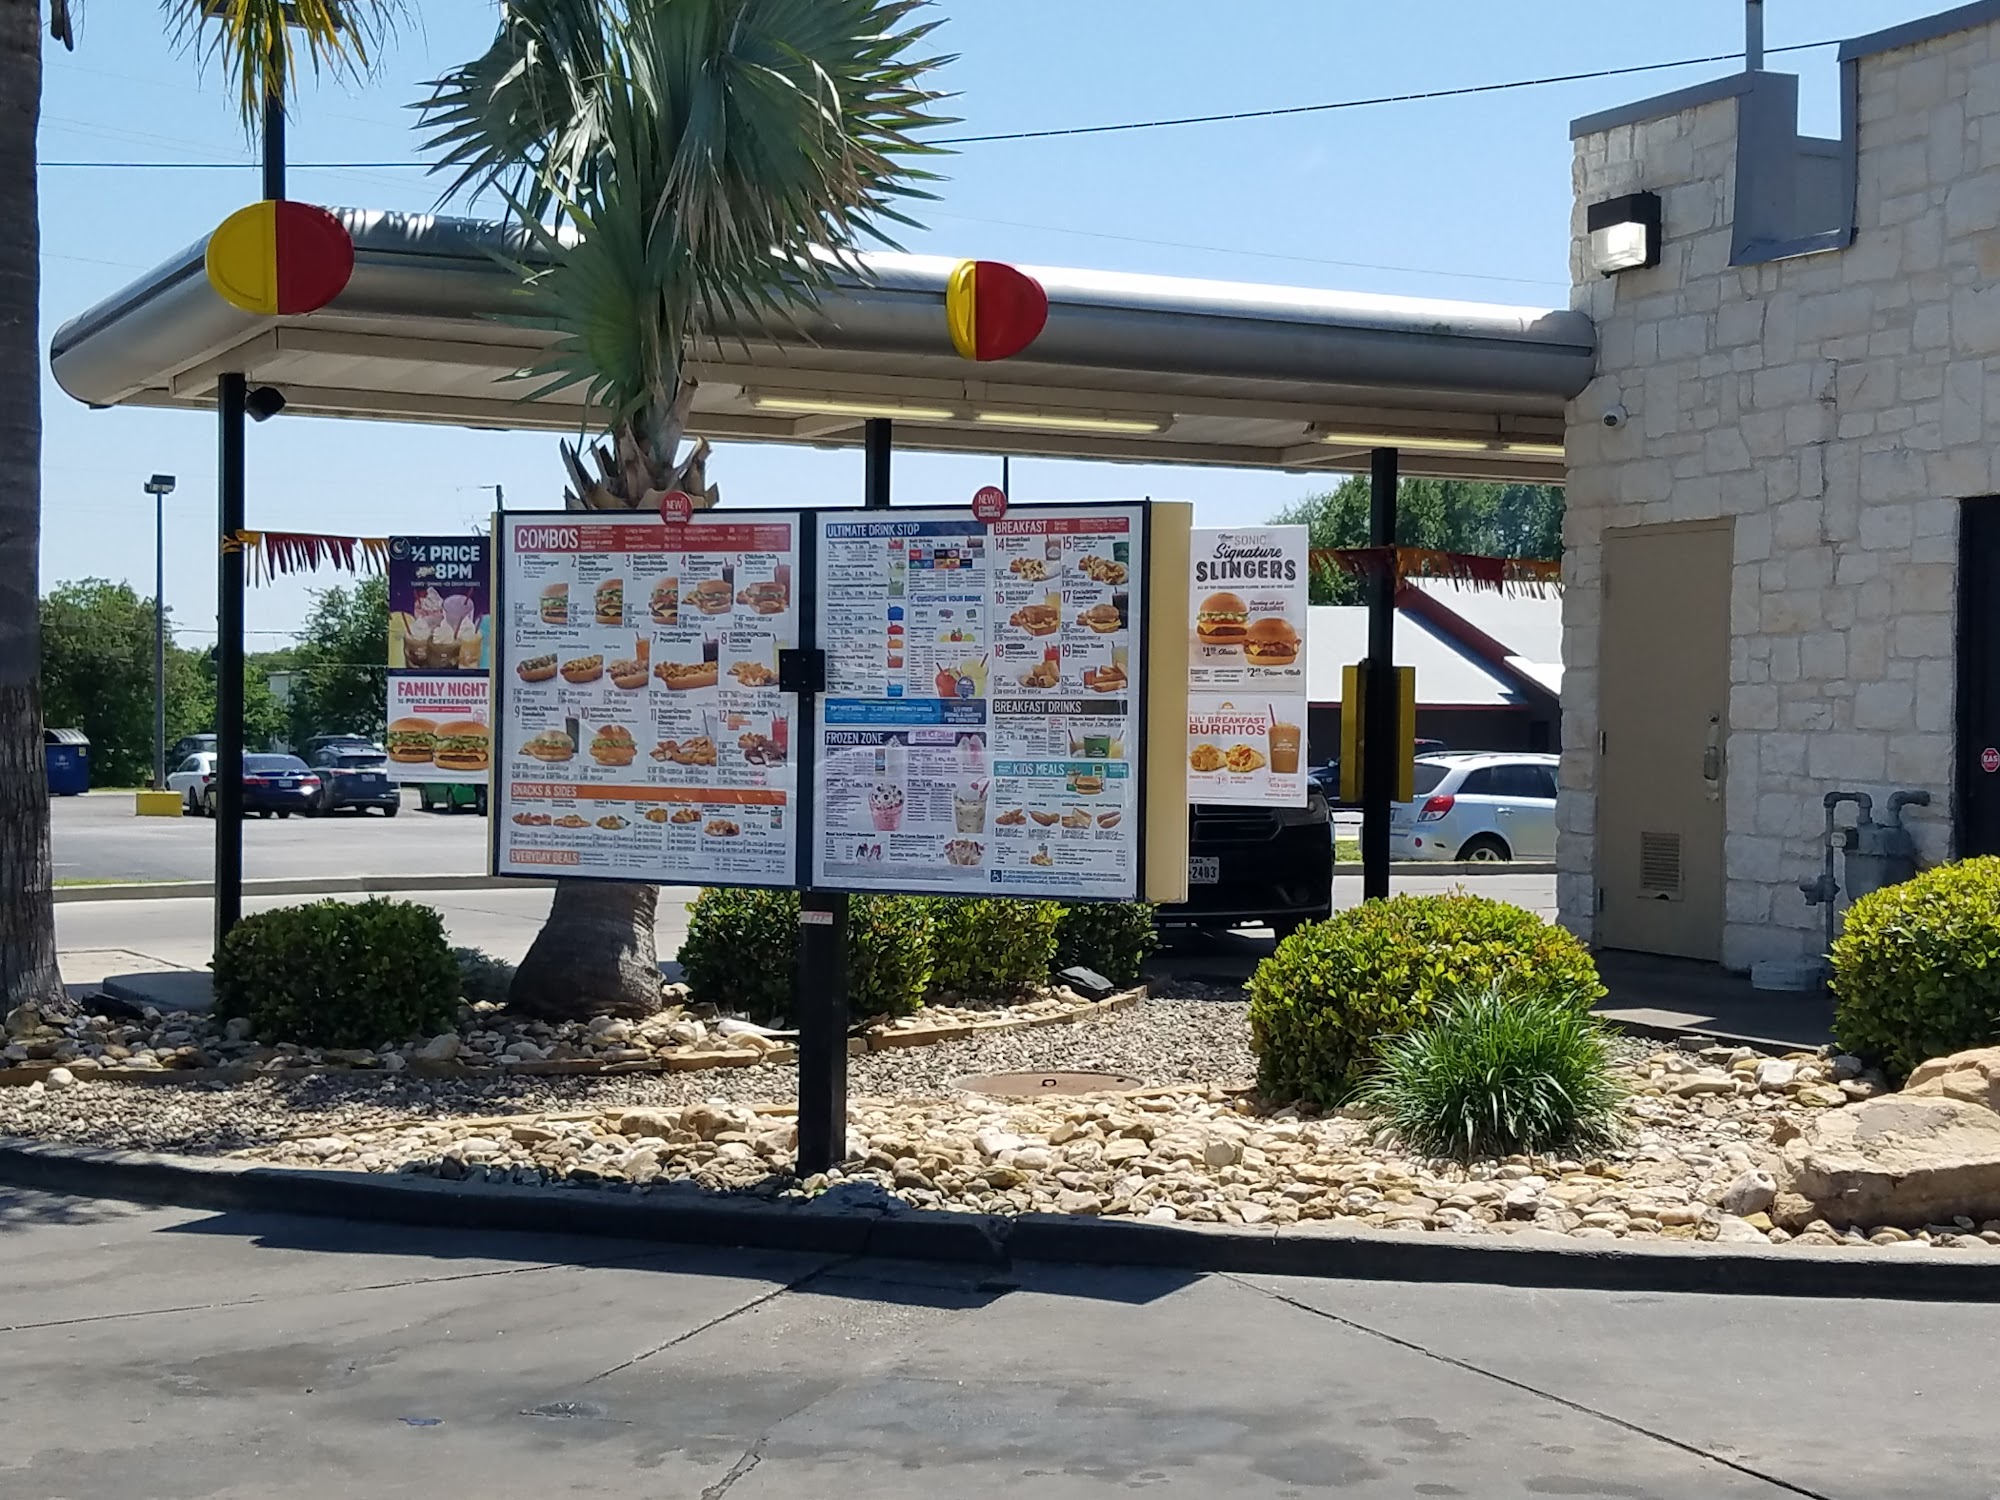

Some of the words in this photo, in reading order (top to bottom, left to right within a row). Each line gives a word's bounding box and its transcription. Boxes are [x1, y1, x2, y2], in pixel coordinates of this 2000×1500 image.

[666, 500, 682, 510] NEW
[978, 494, 995, 504] NEW
[827, 525, 867, 537] ULTIMATE
[868, 524, 896, 536] DRINK
[897, 523, 920, 535] STOP
[995, 521, 1048, 534] BREAKFAST
[518, 528, 579, 549] COMBOS
[995, 537, 1005, 550] 14
[1062, 535, 1073, 550] 15
[1234, 535, 1267, 546] SONIC
[429, 545, 481, 562] PRICE
[1213, 542, 1283, 561] Signature
[570, 554, 577, 568] 2
[625, 554, 632, 568] 3
[680, 555, 687, 568] 4
[736, 554, 743, 568] 5
[435, 563, 473, 579] 8PM
[1196, 560, 1297, 582] SLINGERS
[995, 591, 1005, 604] 16
[1062, 590, 1072, 604] 17
[515, 630, 521, 643] 6
[653, 632, 658, 645] 7
[721, 632, 728, 645] 8
[994, 644, 1004, 658] 18
[1062, 643, 1071, 658] 19
[397, 682, 445, 697] FAMILY
[447, 682, 488, 697] NIGHT
[514, 705, 520, 718] 9
[580, 706, 590, 720] 10
[994, 701, 1046, 713] BREAKFAST
[1048, 701, 1082, 713] DRINKS
[720, 709, 728, 723] 12
[1207, 716, 1267, 725] BREAKFAST
[1189, 724, 1266, 736] BURRITOS
[826, 733, 859, 744] FROZEN
[860, 733, 884, 744] ZONE
[1983, 755, 1998, 763] EAS
[1013, 763, 1034, 774] KIDS
[1035, 763, 1065, 775] MEALS
[512, 785, 543, 796] SNACKS
[544, 787, 552, 797] &
[553, 786, 577, 797] SIDES
[511, 851, 551, 862] EVERYDAY
[552, 852, 579, 864] DEALS
